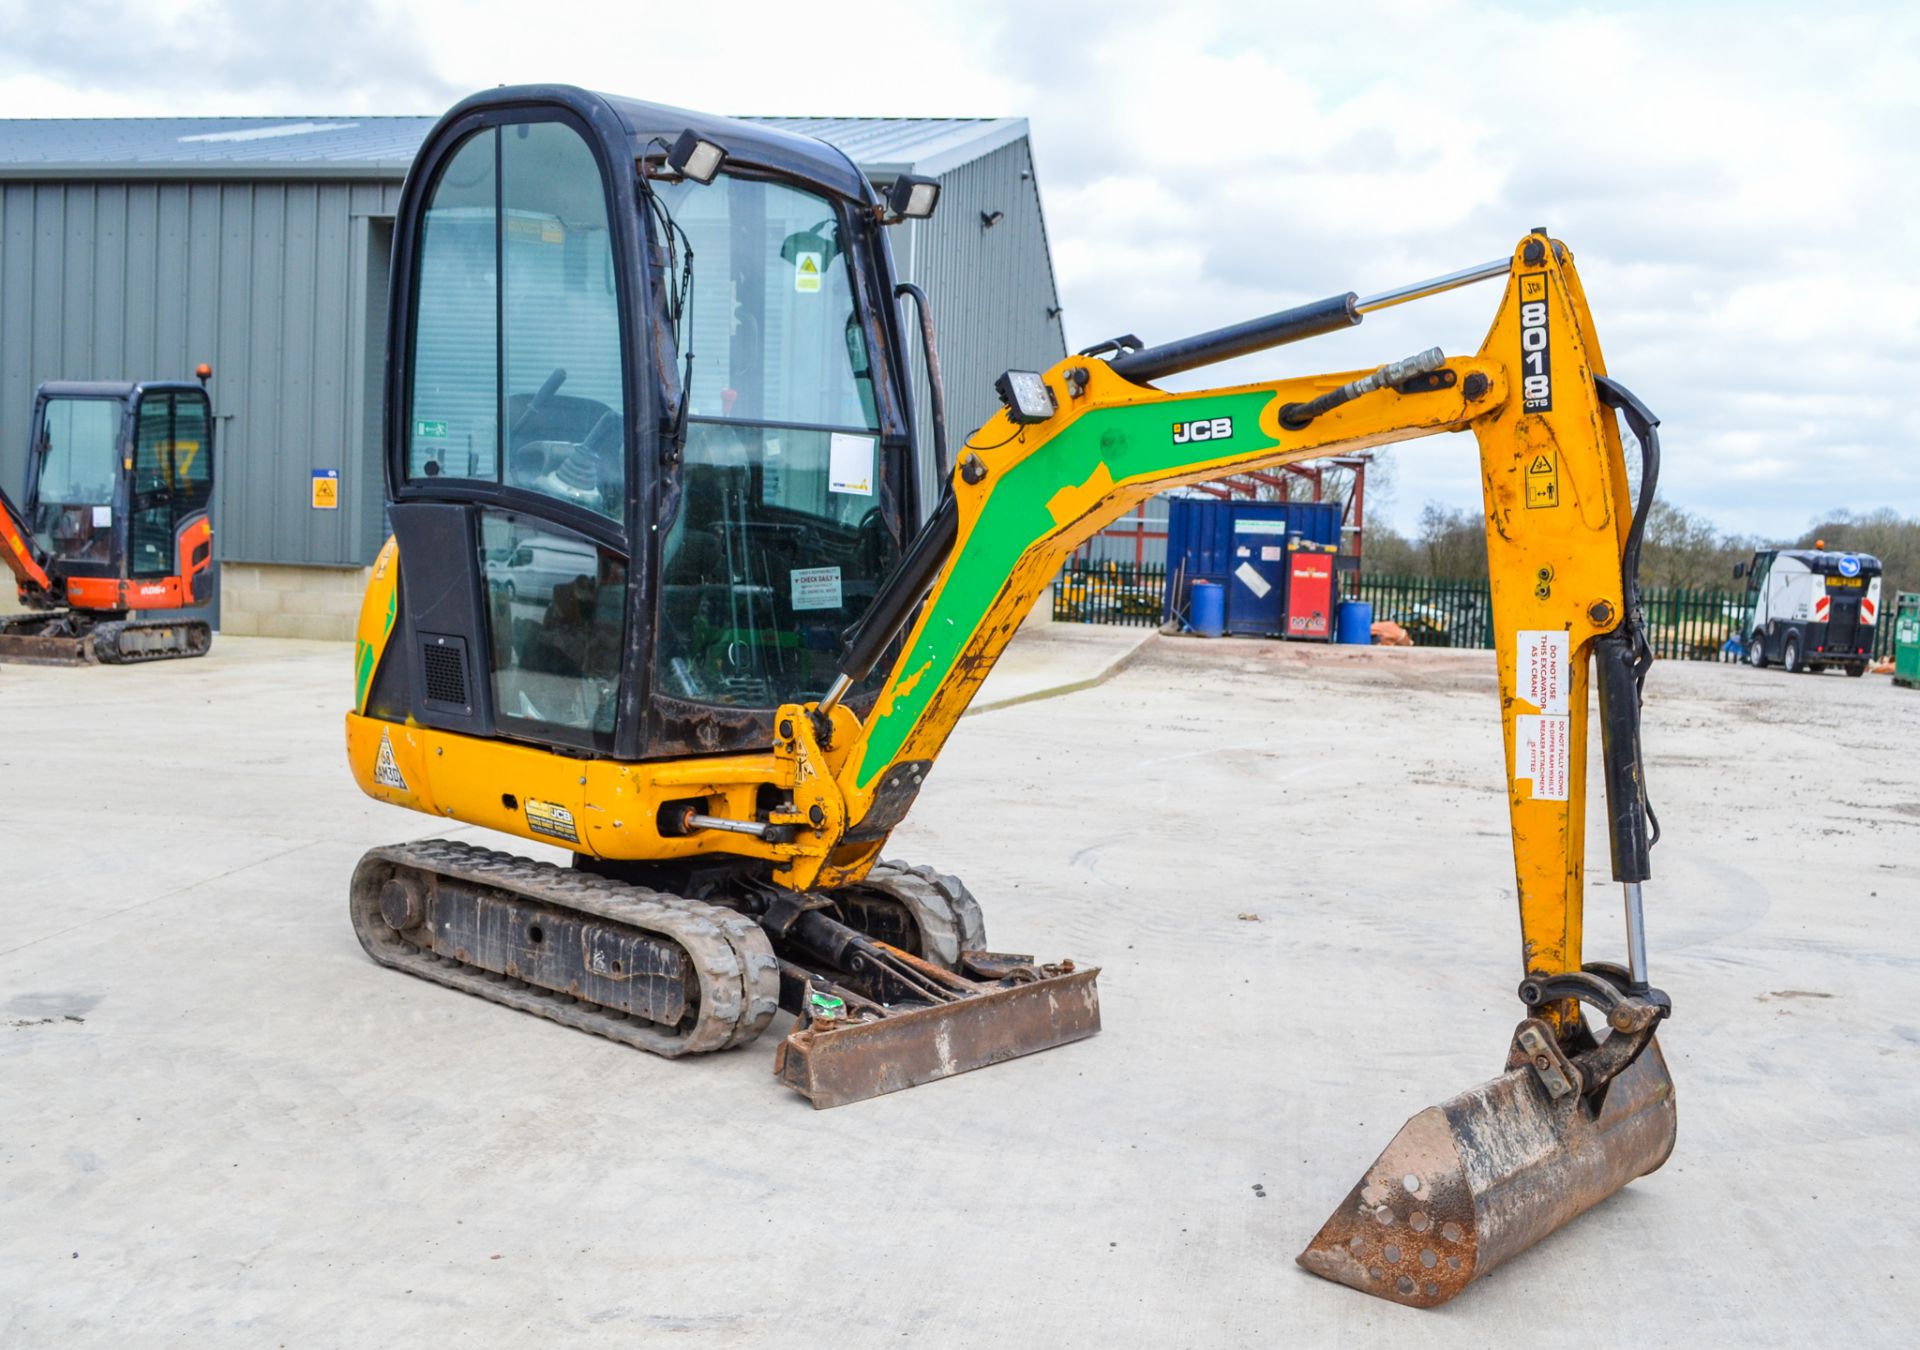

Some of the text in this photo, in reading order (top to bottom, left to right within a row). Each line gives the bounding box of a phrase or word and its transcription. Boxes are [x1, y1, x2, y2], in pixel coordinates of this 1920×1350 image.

[1522, 302, 1549, 399] 8018
[1526, 399, 1548, 408] CTS
[1173, 417, 1232, 443] JCB
[1531, 646, 1538, 657] AS
[1549, 645, 1557, 659] DO
[1558, 721, 1564, 732] DO
[551, 807, 572, 822] JCB
